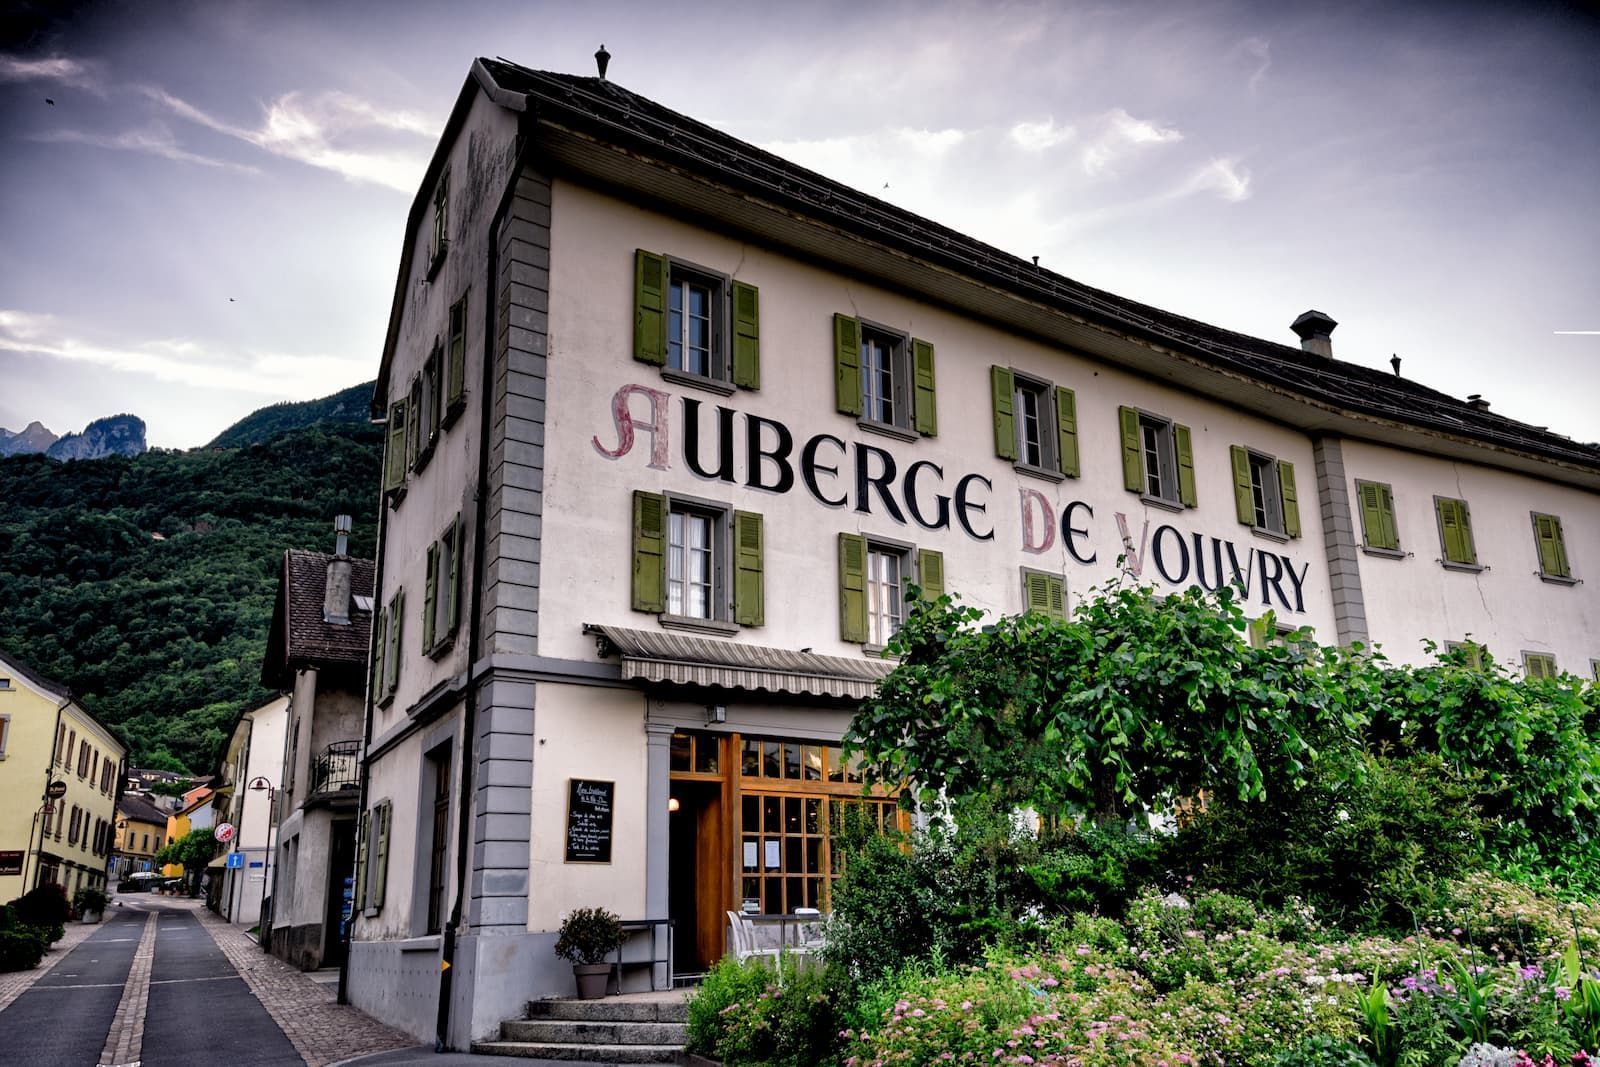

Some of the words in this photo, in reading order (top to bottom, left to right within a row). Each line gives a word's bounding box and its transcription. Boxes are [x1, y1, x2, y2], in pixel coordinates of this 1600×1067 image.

[592, 383, 995, 541] AUBERGE
[1018, 487, 1097, 565] DE
[1113, 511, 1309, 614] VOUVRY
